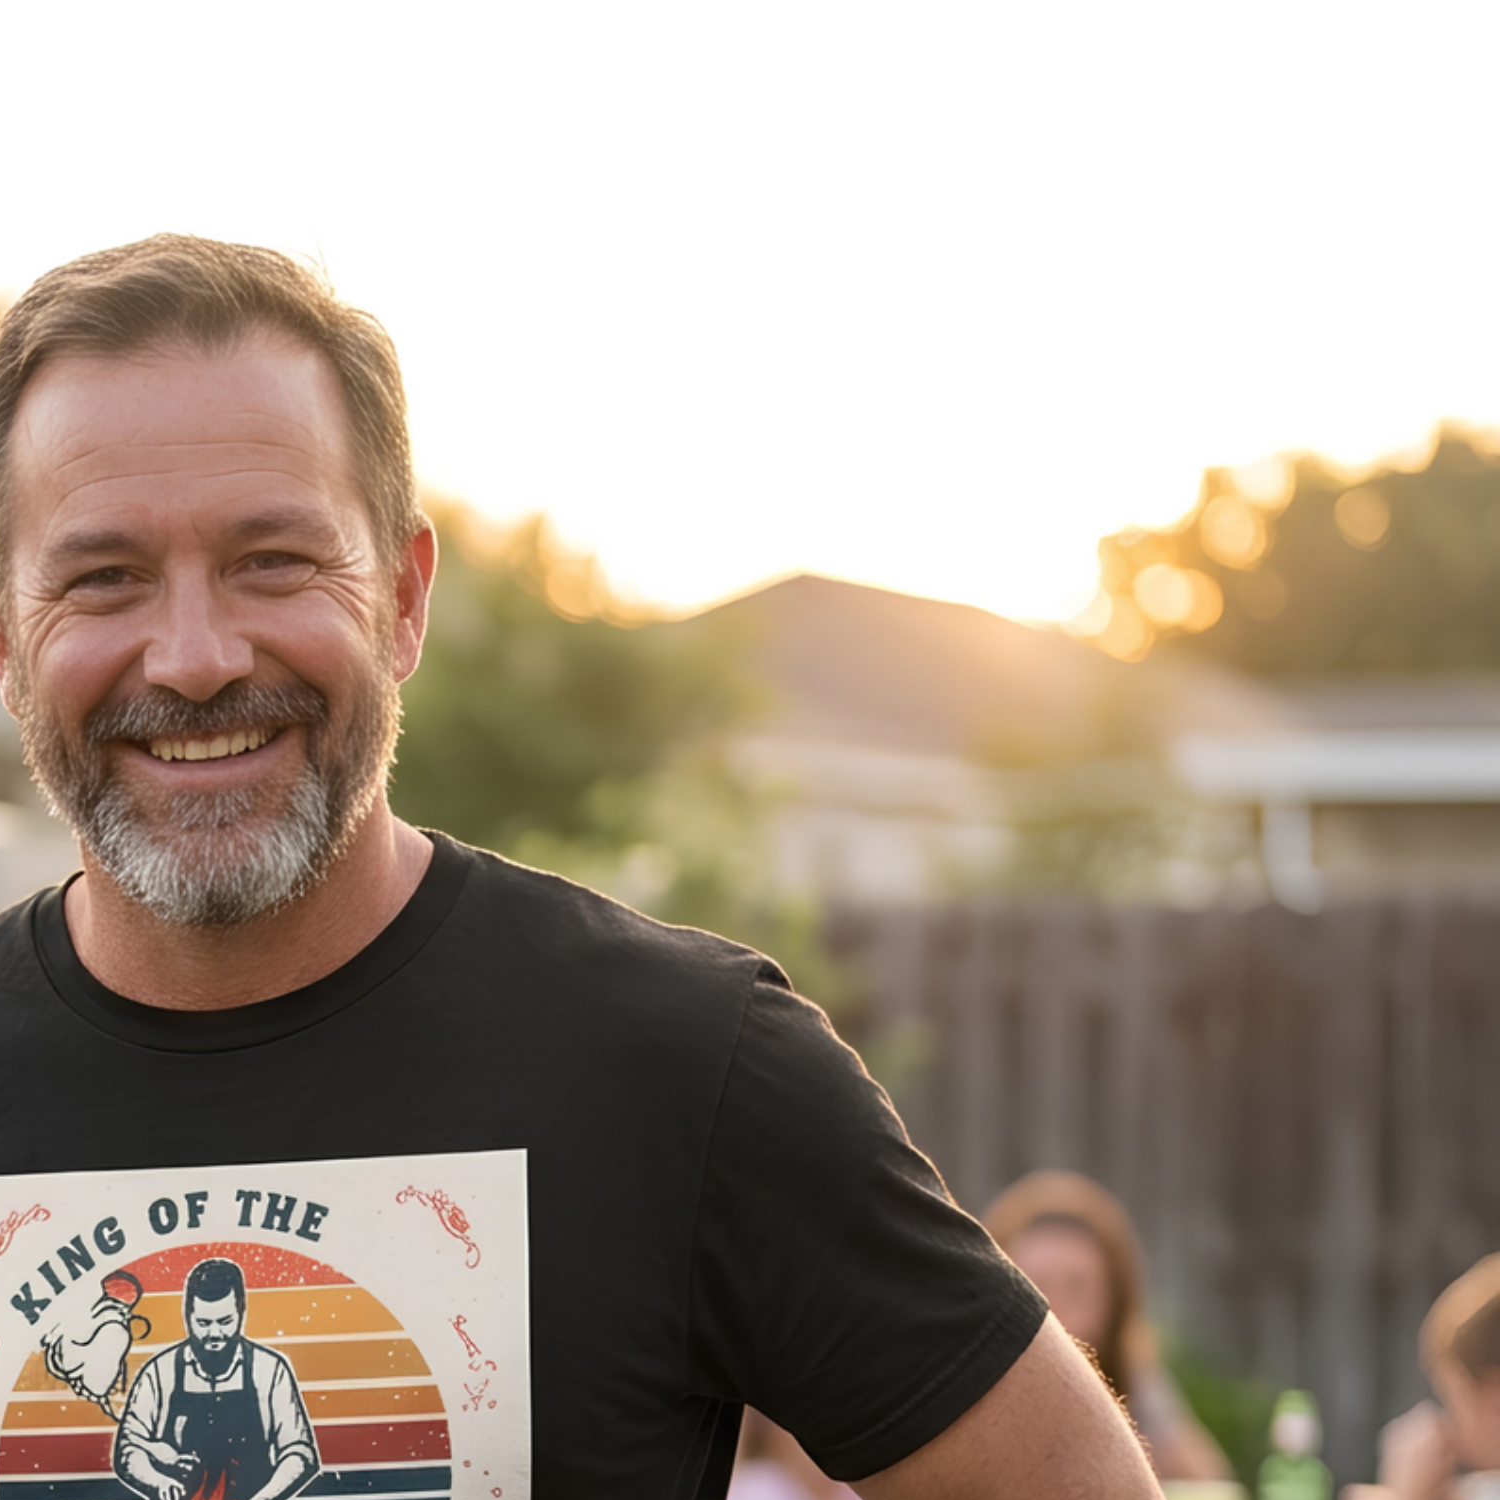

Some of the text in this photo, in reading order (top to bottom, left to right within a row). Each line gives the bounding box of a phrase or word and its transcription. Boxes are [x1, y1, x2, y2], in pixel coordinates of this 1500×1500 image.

[10, 1188, 330, 1326] KING OF THE
